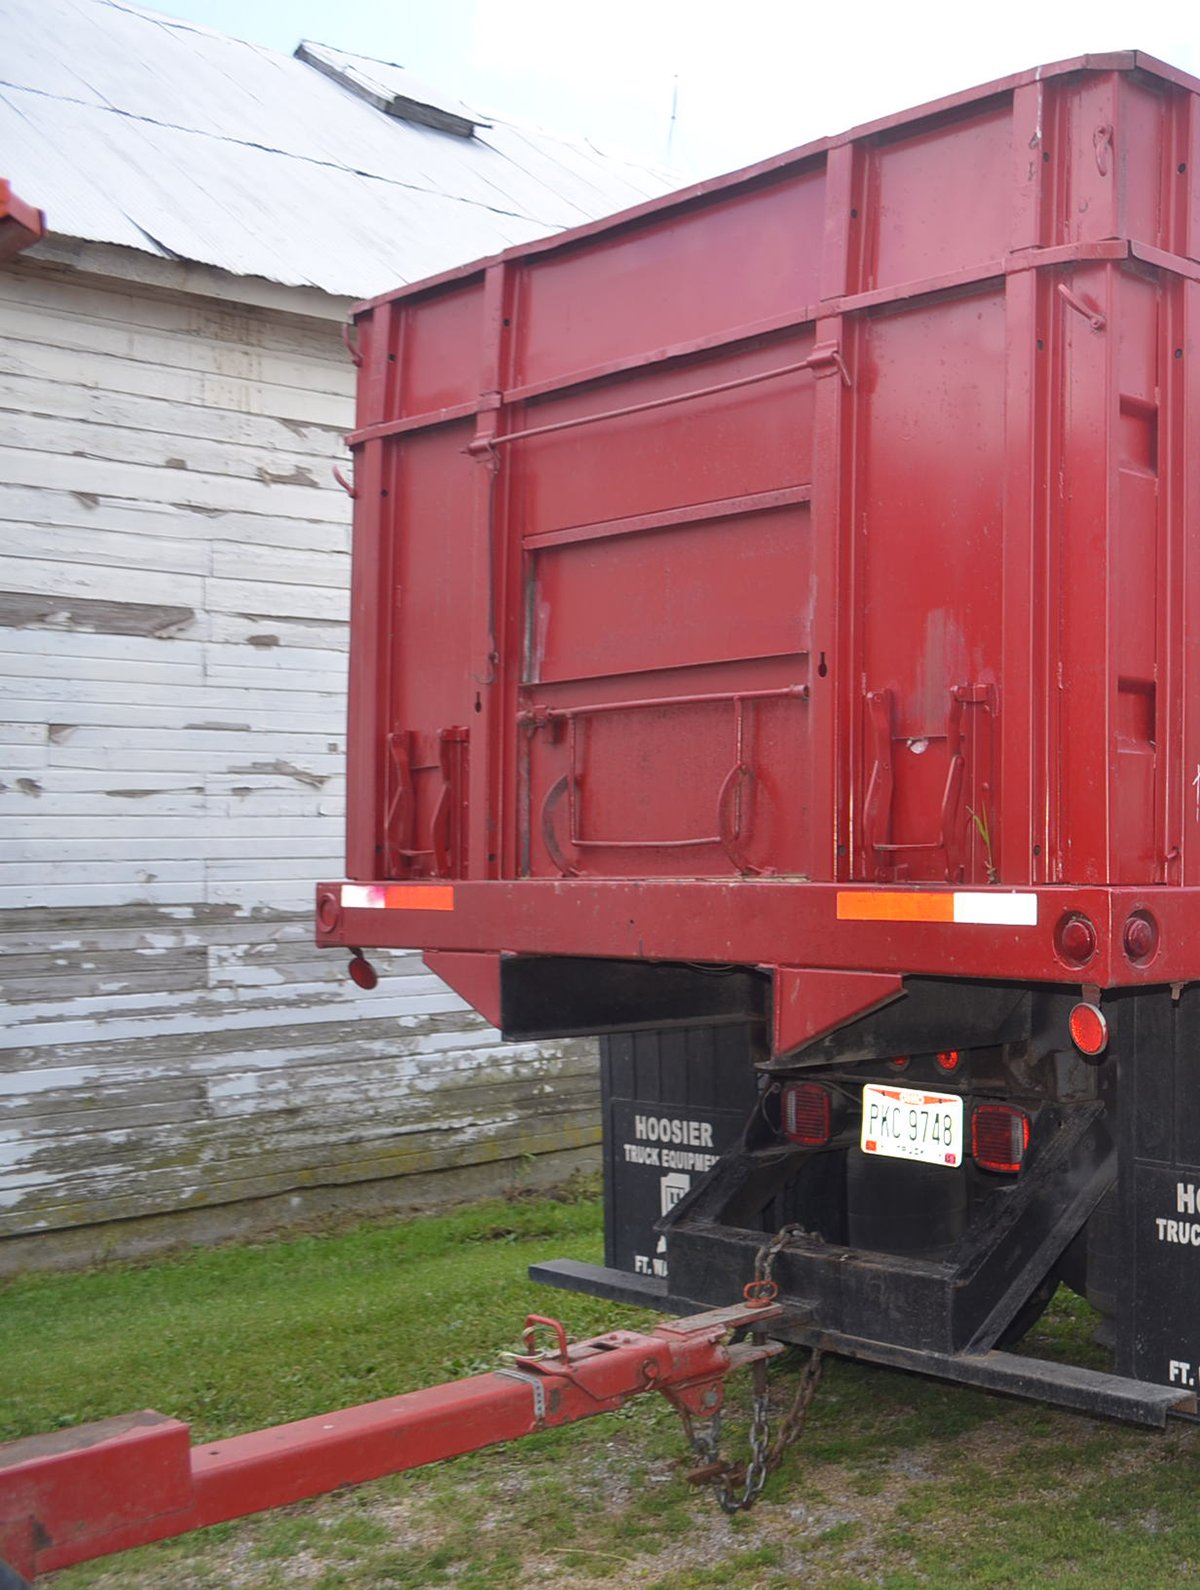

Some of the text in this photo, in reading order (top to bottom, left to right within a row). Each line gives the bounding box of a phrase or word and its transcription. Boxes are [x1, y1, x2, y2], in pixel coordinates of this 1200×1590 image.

[635, 1115, 714, 1148] HOOSIER
[869, 1104, 953, 1146] PKC 9748
[623, 1144, 662, 1166] TRUCK
[634, 1255, 652, 1275] FT.
[1169, 1360, 1195, 1386] FT.
